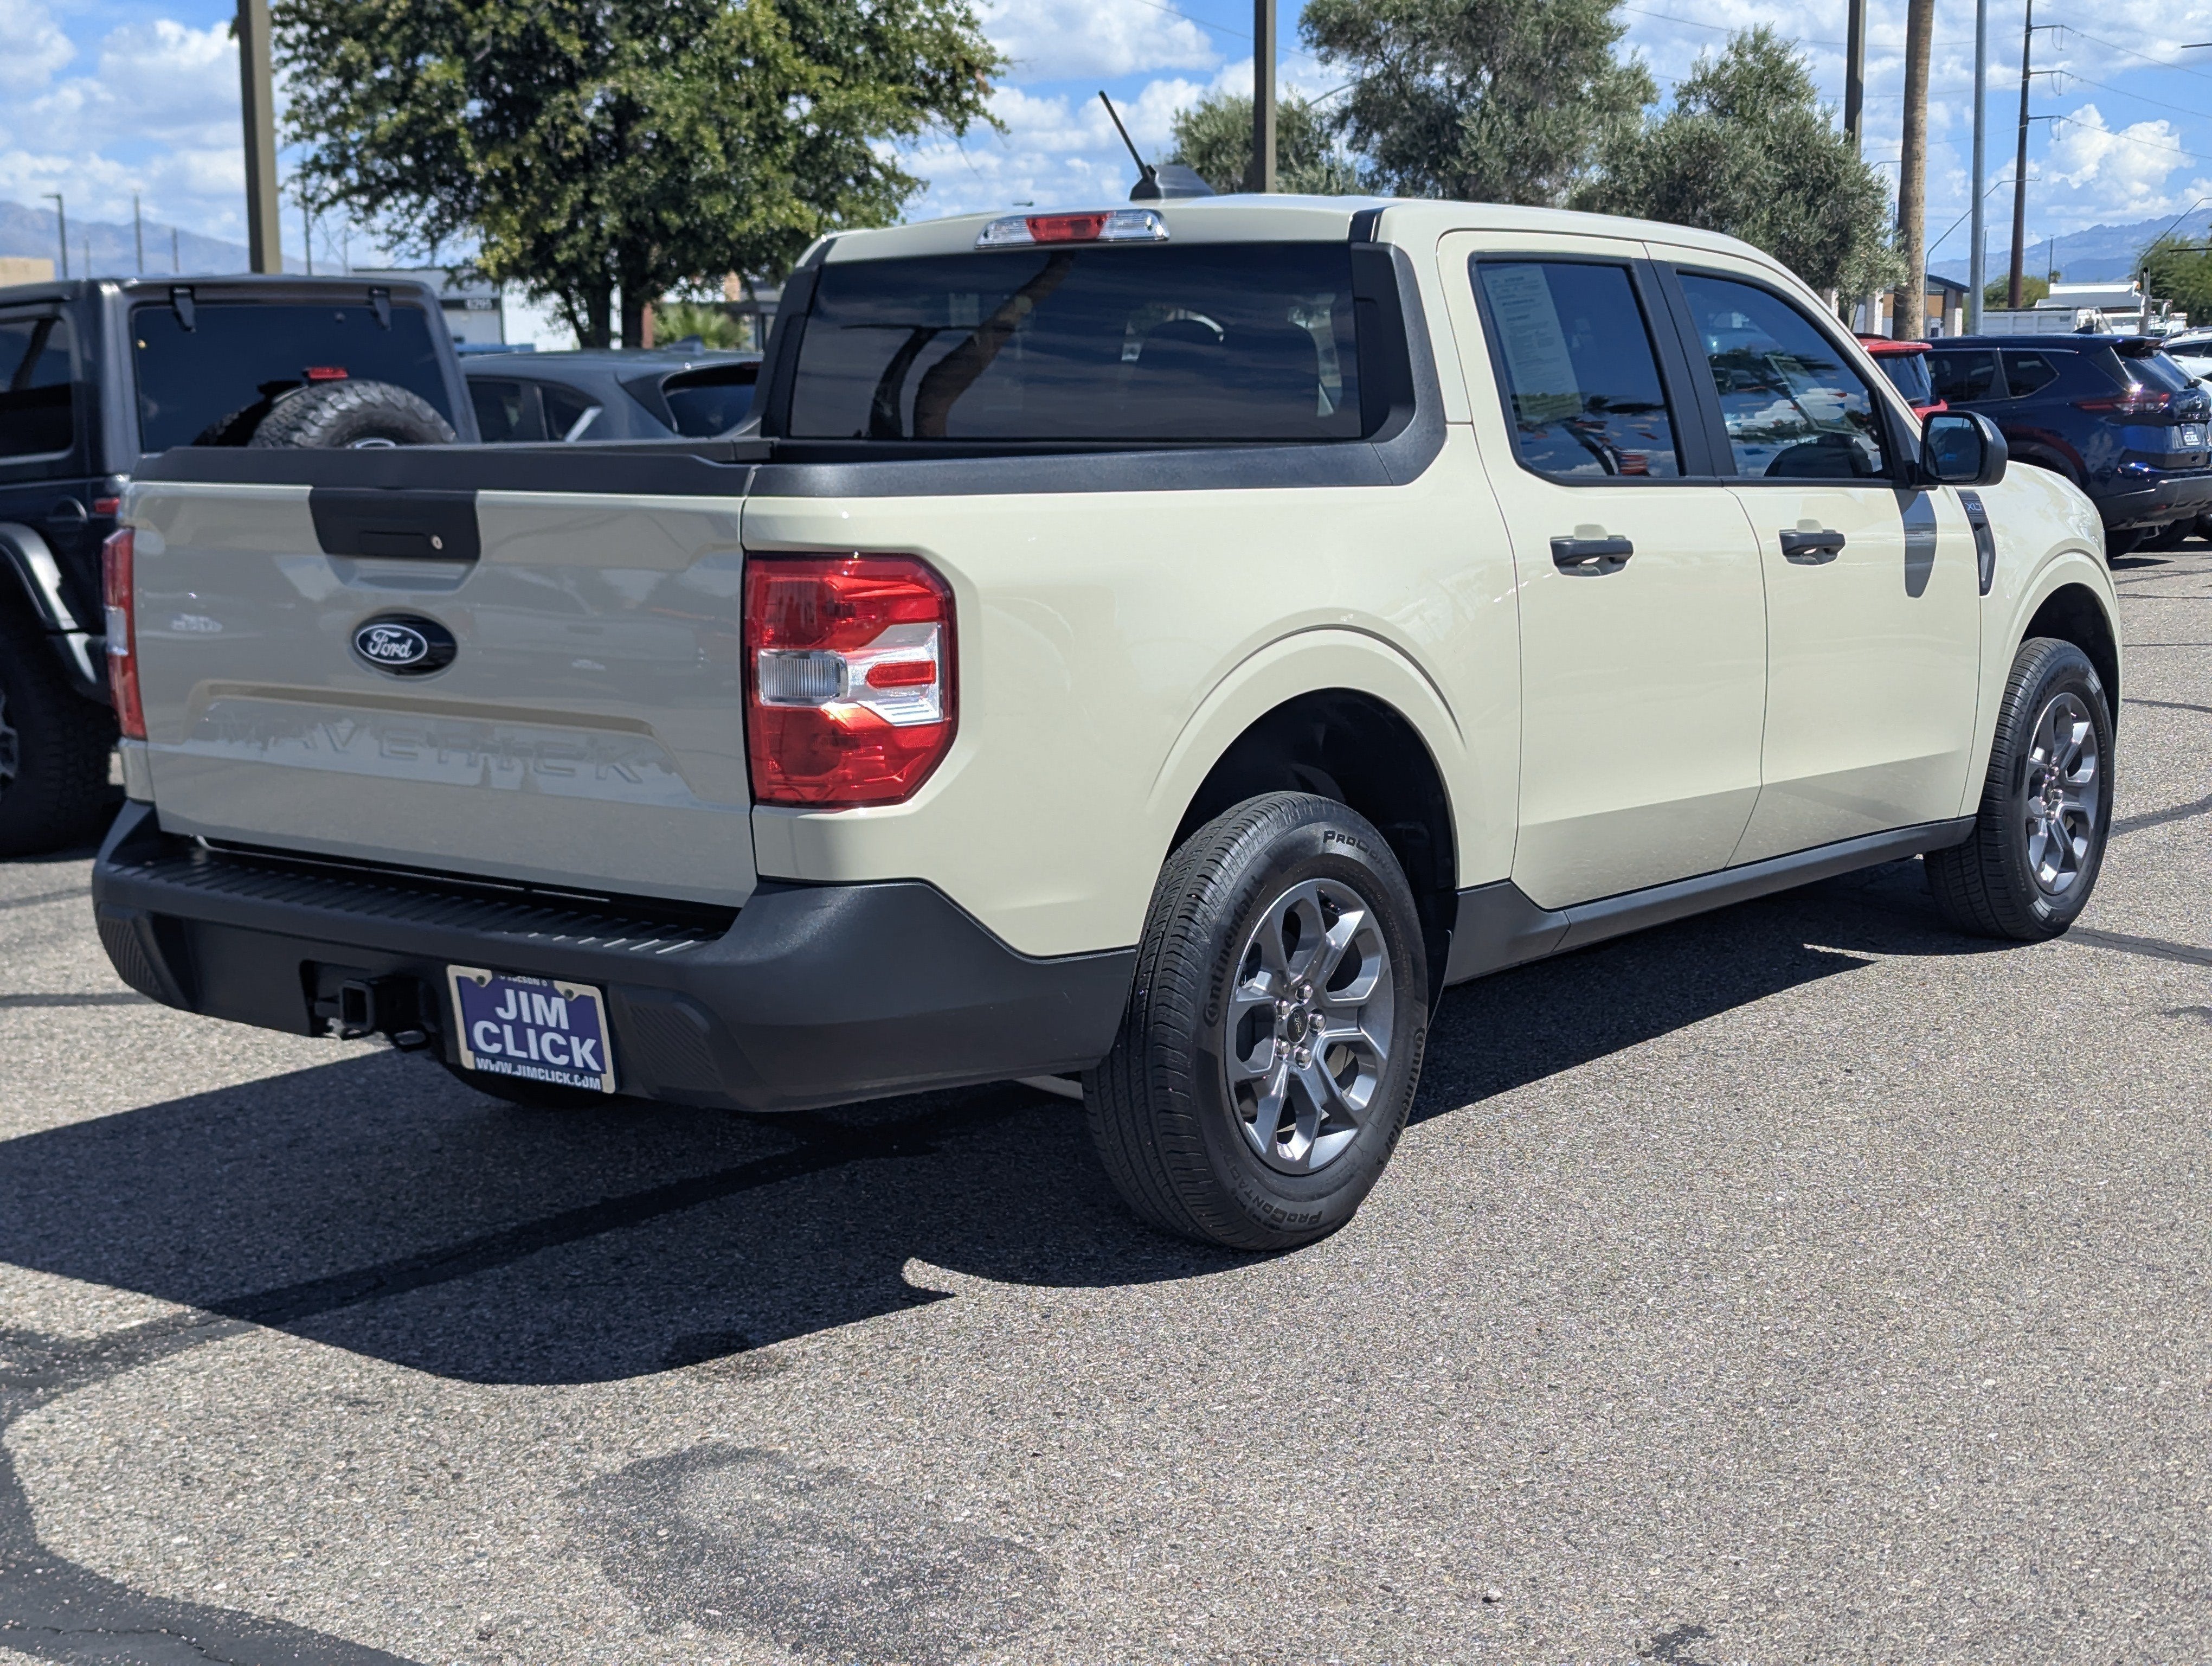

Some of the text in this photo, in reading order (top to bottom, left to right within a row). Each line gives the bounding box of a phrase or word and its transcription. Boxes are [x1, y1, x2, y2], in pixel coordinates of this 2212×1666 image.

[1965, 503, 1982, 511] XLT
[368, 630, 412, 657] Ford
[495, 988, 569, 1030] JIM
[473, 1020, 602, 1072] CLICK
[475, 1057, 601, 1090] WWW.JIMCLICK.COM
